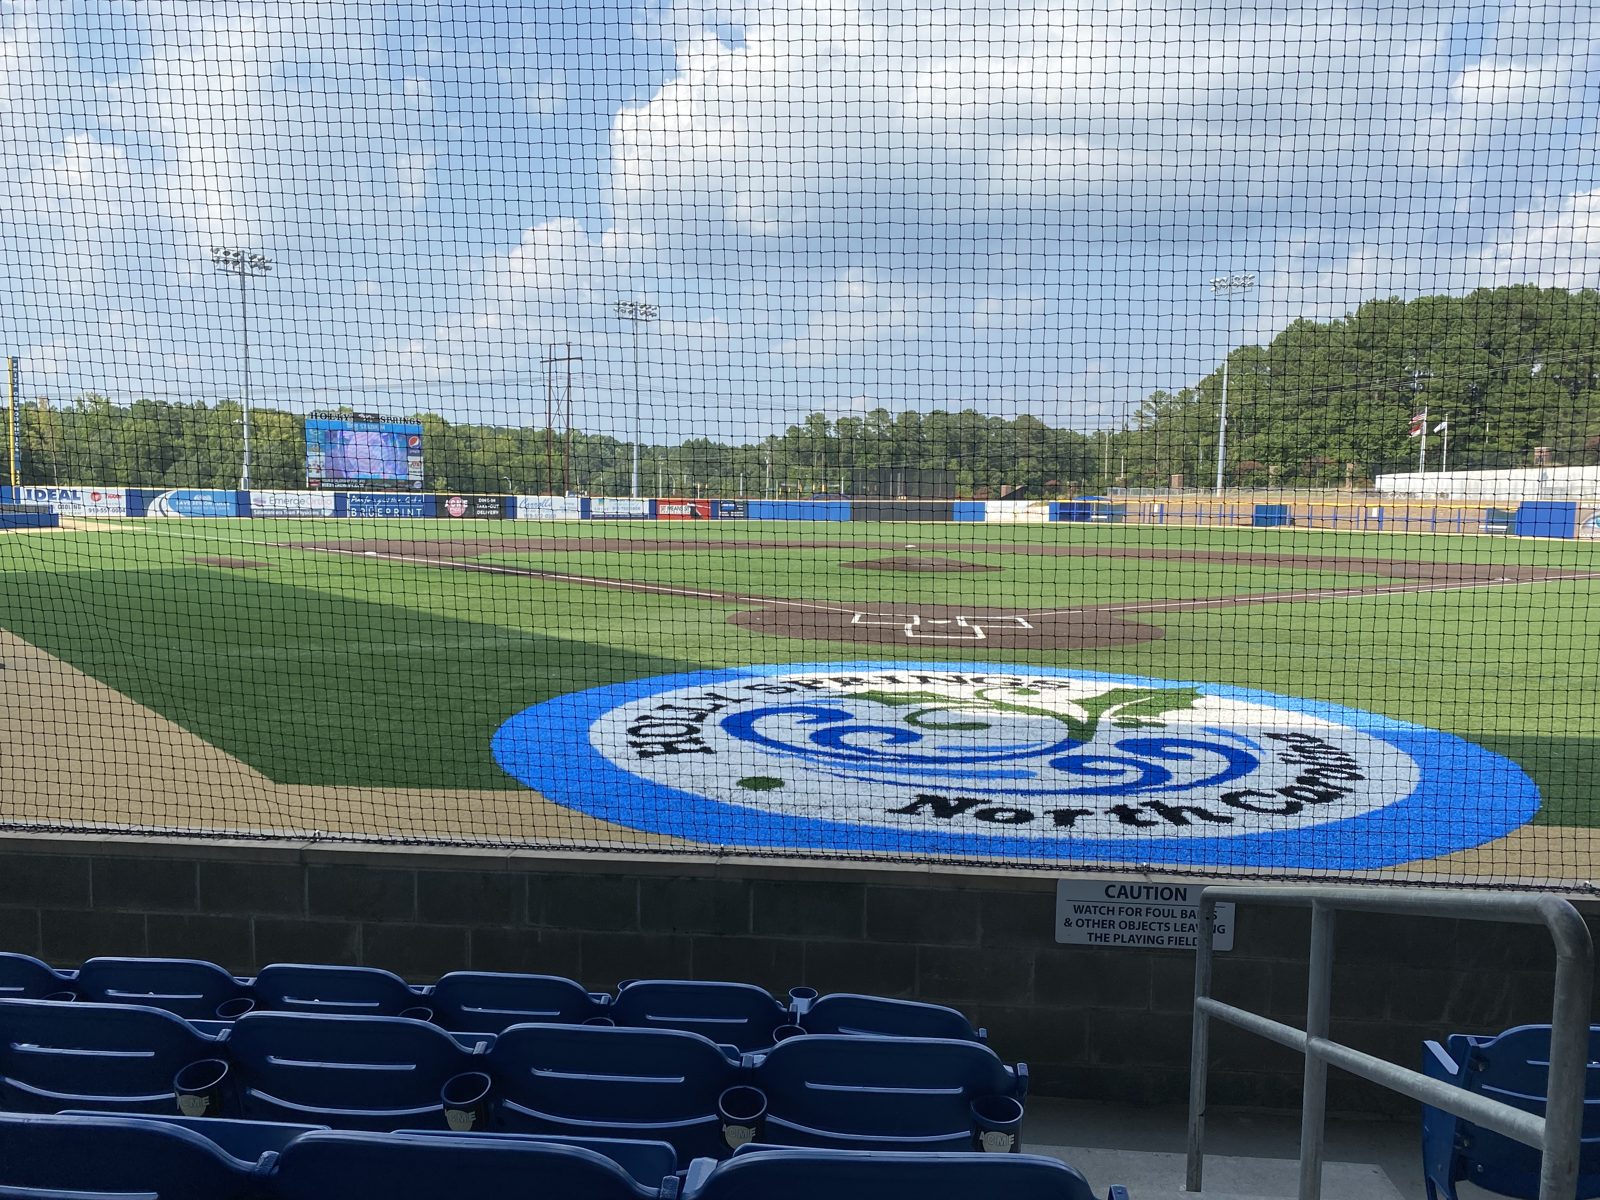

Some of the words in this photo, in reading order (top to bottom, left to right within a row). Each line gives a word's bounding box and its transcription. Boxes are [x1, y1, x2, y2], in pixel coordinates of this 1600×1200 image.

[310, 411, 349, 420] HOLLY
[380, 415, 421, 425] SPRINGS
[26, 489, 81, 500] IDEAL
[627, 692, 750, 758] HOLLY
[742, 674, 1068, 694] SPRINGS
[888, 794, 1235, 828] North
[1220, 732, 1366, 815] Carolina
[1104, 884, 1188, 902] CAUTION
[1073, 904, 1116, 916] WATCH
[1118, 907, 1143, 917] FOR
[1145, 908, 1178, 919] FOUL
[1180, 910, 1218, 921] BAS
[1063, 918, 1073, 928] &
[1075, 918, 1116, 930] OTHER
[1118, 921, 1171, 932] OBJECTS
[1173, 922, 1227, 935] LEAVNG
[1087, 932, 1111, 943] THE
[1113, 934, 1165, 945] PLAYING
[979, 1130, 1015, 1146] ACME
